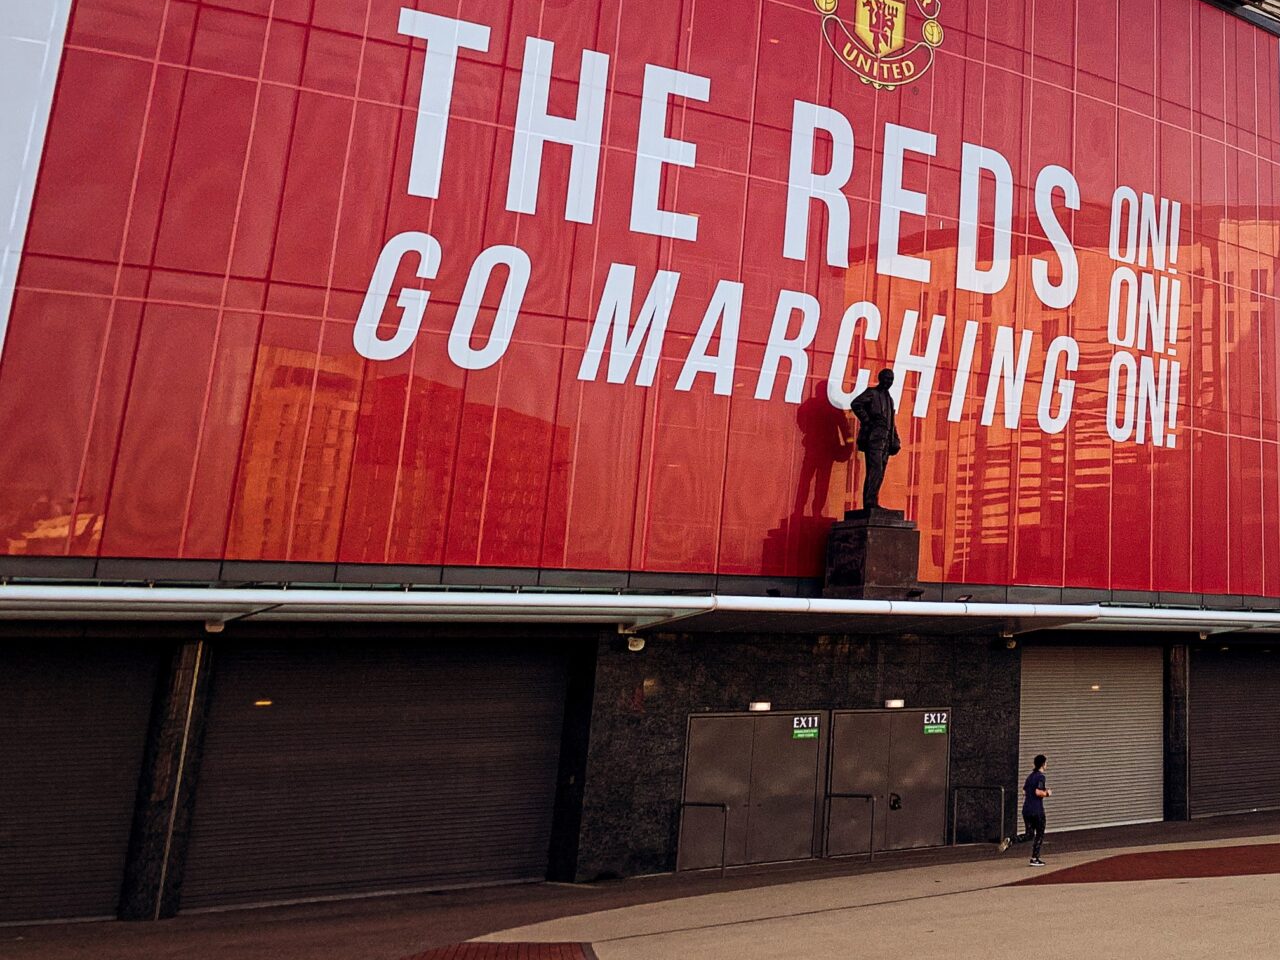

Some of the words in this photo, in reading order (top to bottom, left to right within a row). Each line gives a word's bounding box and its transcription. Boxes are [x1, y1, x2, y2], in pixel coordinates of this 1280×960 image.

[842, 42, 915, 79] UNITED
[397, 6, 711, 241] THE
[782, 99, 1080, 310] REDS
[1109, 185, 1182, 274] ON!
[353, 231, 532, 370] GO
[577, 262, 1079, 436] MARCHING
[1107, 266, 1181, 356] ON!
[1106, 351, 1181, 448] ON!
[793, 716, 818, 728] EX11
[924, 713, 947, 724] EX12
